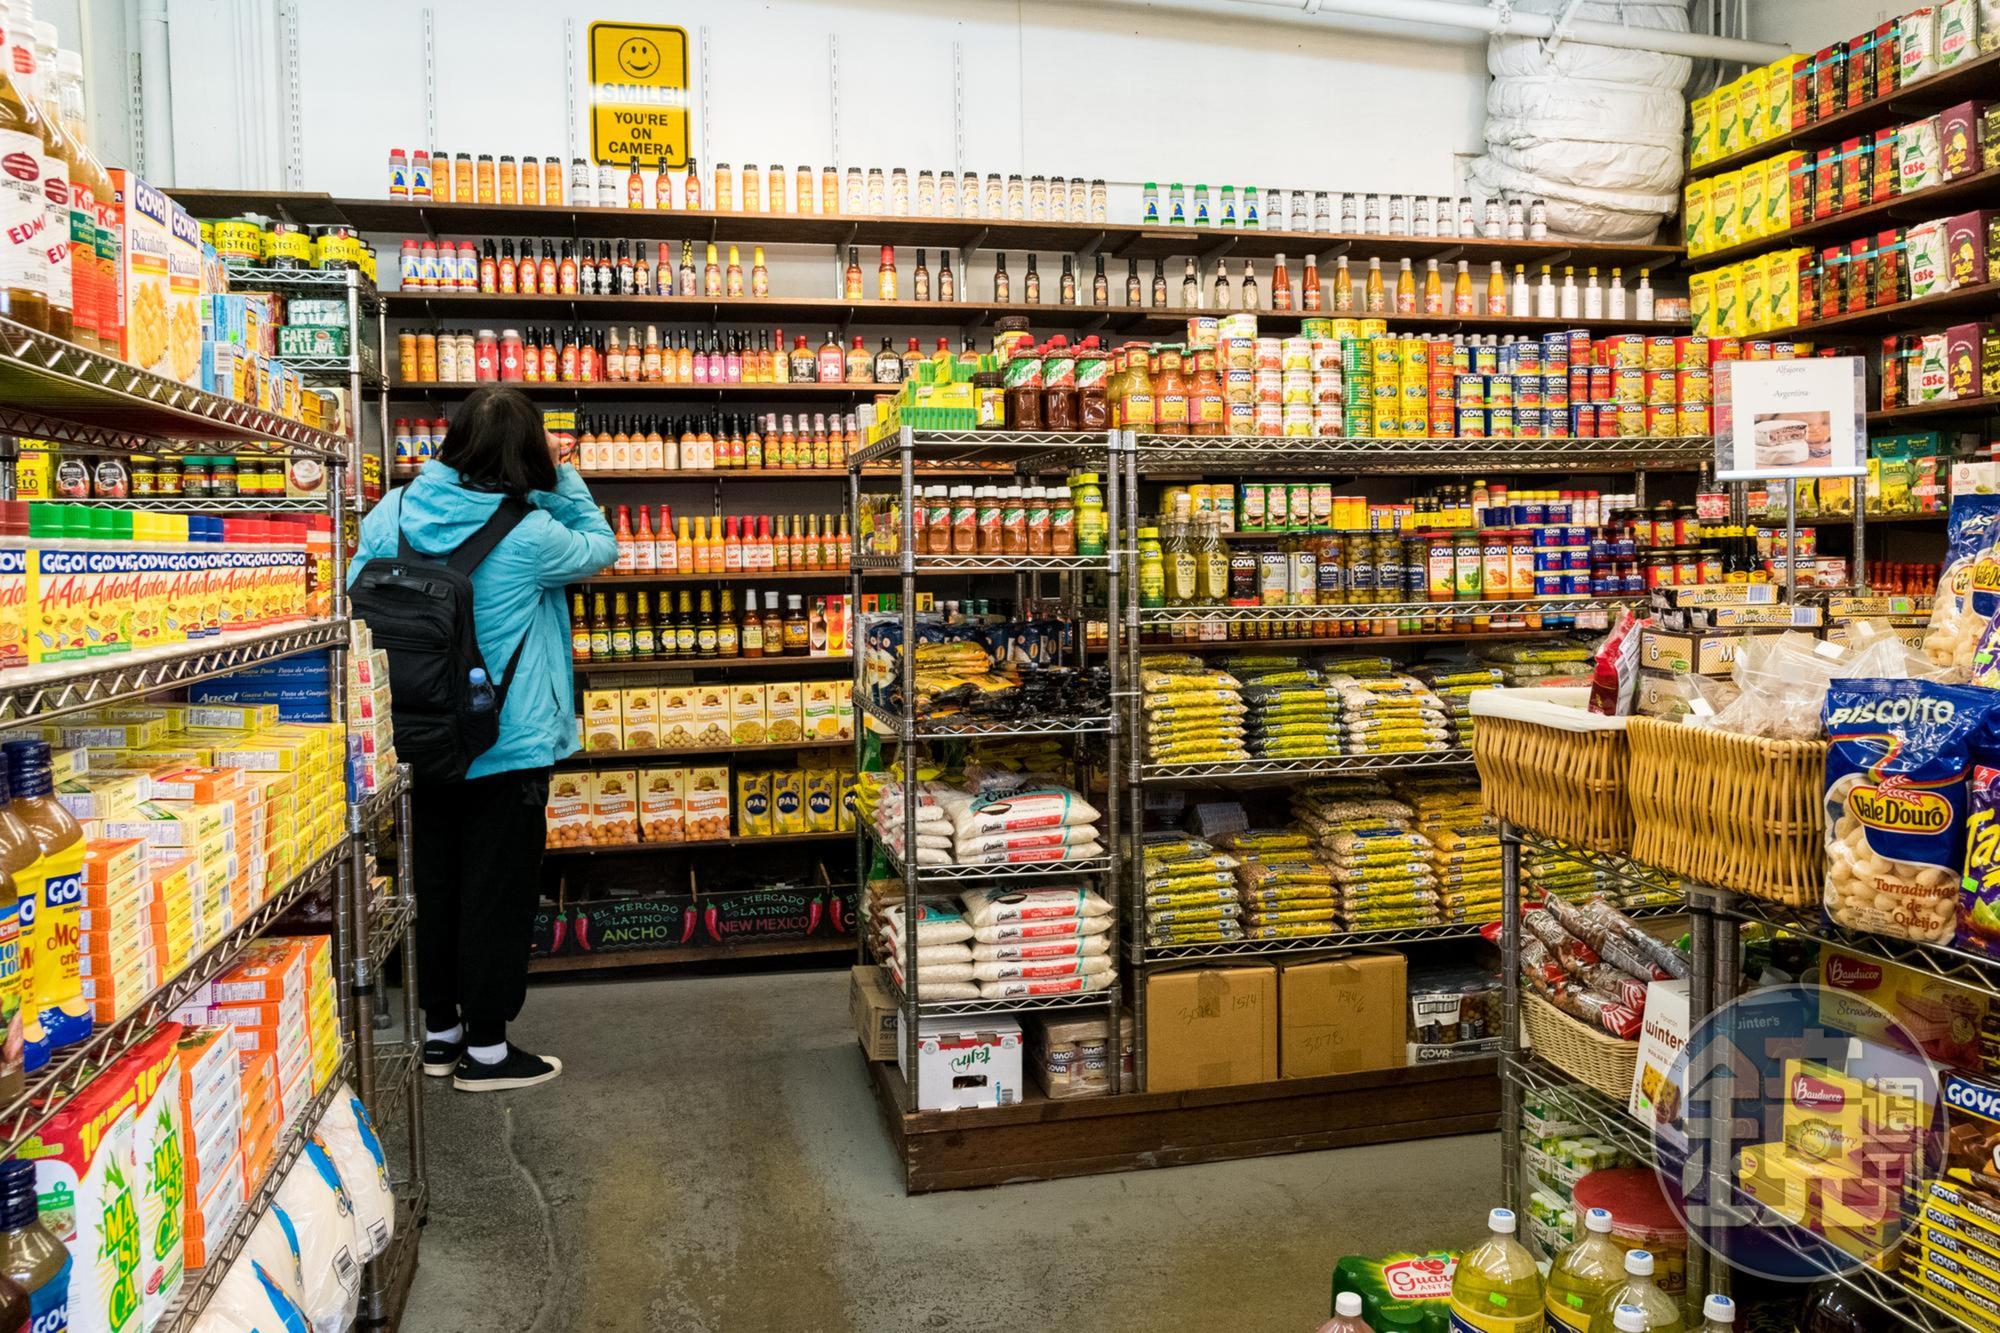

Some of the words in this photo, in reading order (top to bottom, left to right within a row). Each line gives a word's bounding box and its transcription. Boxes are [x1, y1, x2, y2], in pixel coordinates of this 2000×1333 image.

[614, 112, 668, 126] YOU'RE
[630, 127, 652, 140] ON
[608, 141, 674, 156] CAMERA
[1903, 161, 1926, 176] CBSe
[136, 184, 166, 223] GOYA
[172, 211, 198, 246] GOYA
[1913, 269, 1935, 284] CBSe
[281, 342, 299, 354] LA
[302, 341, 336, 354] LLAVE
[1518, 343, 1539, 351] GOYA
[1625, 336, 1643, 344] GOYA
[1520, 377, 1539, 385] GOYA
[1921, 373, 1945, 387] CBSe
[1624, 405, 1643, 413] GOYA
[1483, 546, 1508, 555] GOYA
[1231, 559, 1256, 568] GOYA
[1263, 555, 1286, 564] GOYA
[1319, 565, 1339, 573] GOYA
[1651, 645, 1659, 661] 6
[198, 692, 239, 704] Ancel
[1827, 697, 1955, 727] BISCOITO
[1853, 794, 1883, 822] Vale
[1885, 799, 1945, 827] D'ouro
[1873, 877, 1957, 898] Torradinhas
[722, 900, 738, 911] EL
[743, 893, 805, 906] MERCADO
[1906, 899, 1922, 913] de
[593, 910, 609, 921] EL
[614, 902, 679, 915] MERCADO
[740, 905, 789, 916] LATINO
[610, 914, 662, 925] LATINO
[719, 918, 754, 933] NEW
[760, 916, 809, 931] MEXICO
[1893, 912, 1940, 933] Queijo
[602, 926, 668, 943] ANCHO
[1829, 957, 1880, 986] Bauducco
[1836, 1000, 1896, 1024] Strawberry
[1644, 1018, 1692, 1057] winter's
[1420, 1049, 1450, 1059] GOYA
[1793, 1076, 1842, 1106] Bauducco
[1801, 1121, 1858, 1148] Strawberry
[1930, 1184, 1960, 1205] GOYA
[105, 1191, 137, 1251] MA
[1927, 1209, 1957, 1230] GOYA
[1928, 1231, 1957, 1251] GOYA
[1929, 1252, 1959, 1274] GOYA
[1419, 1281, 1451, 1292] ANTA
[1926, 1270, 1956, 1293] GOYA
[111, 1279, 137, 1332] CA
